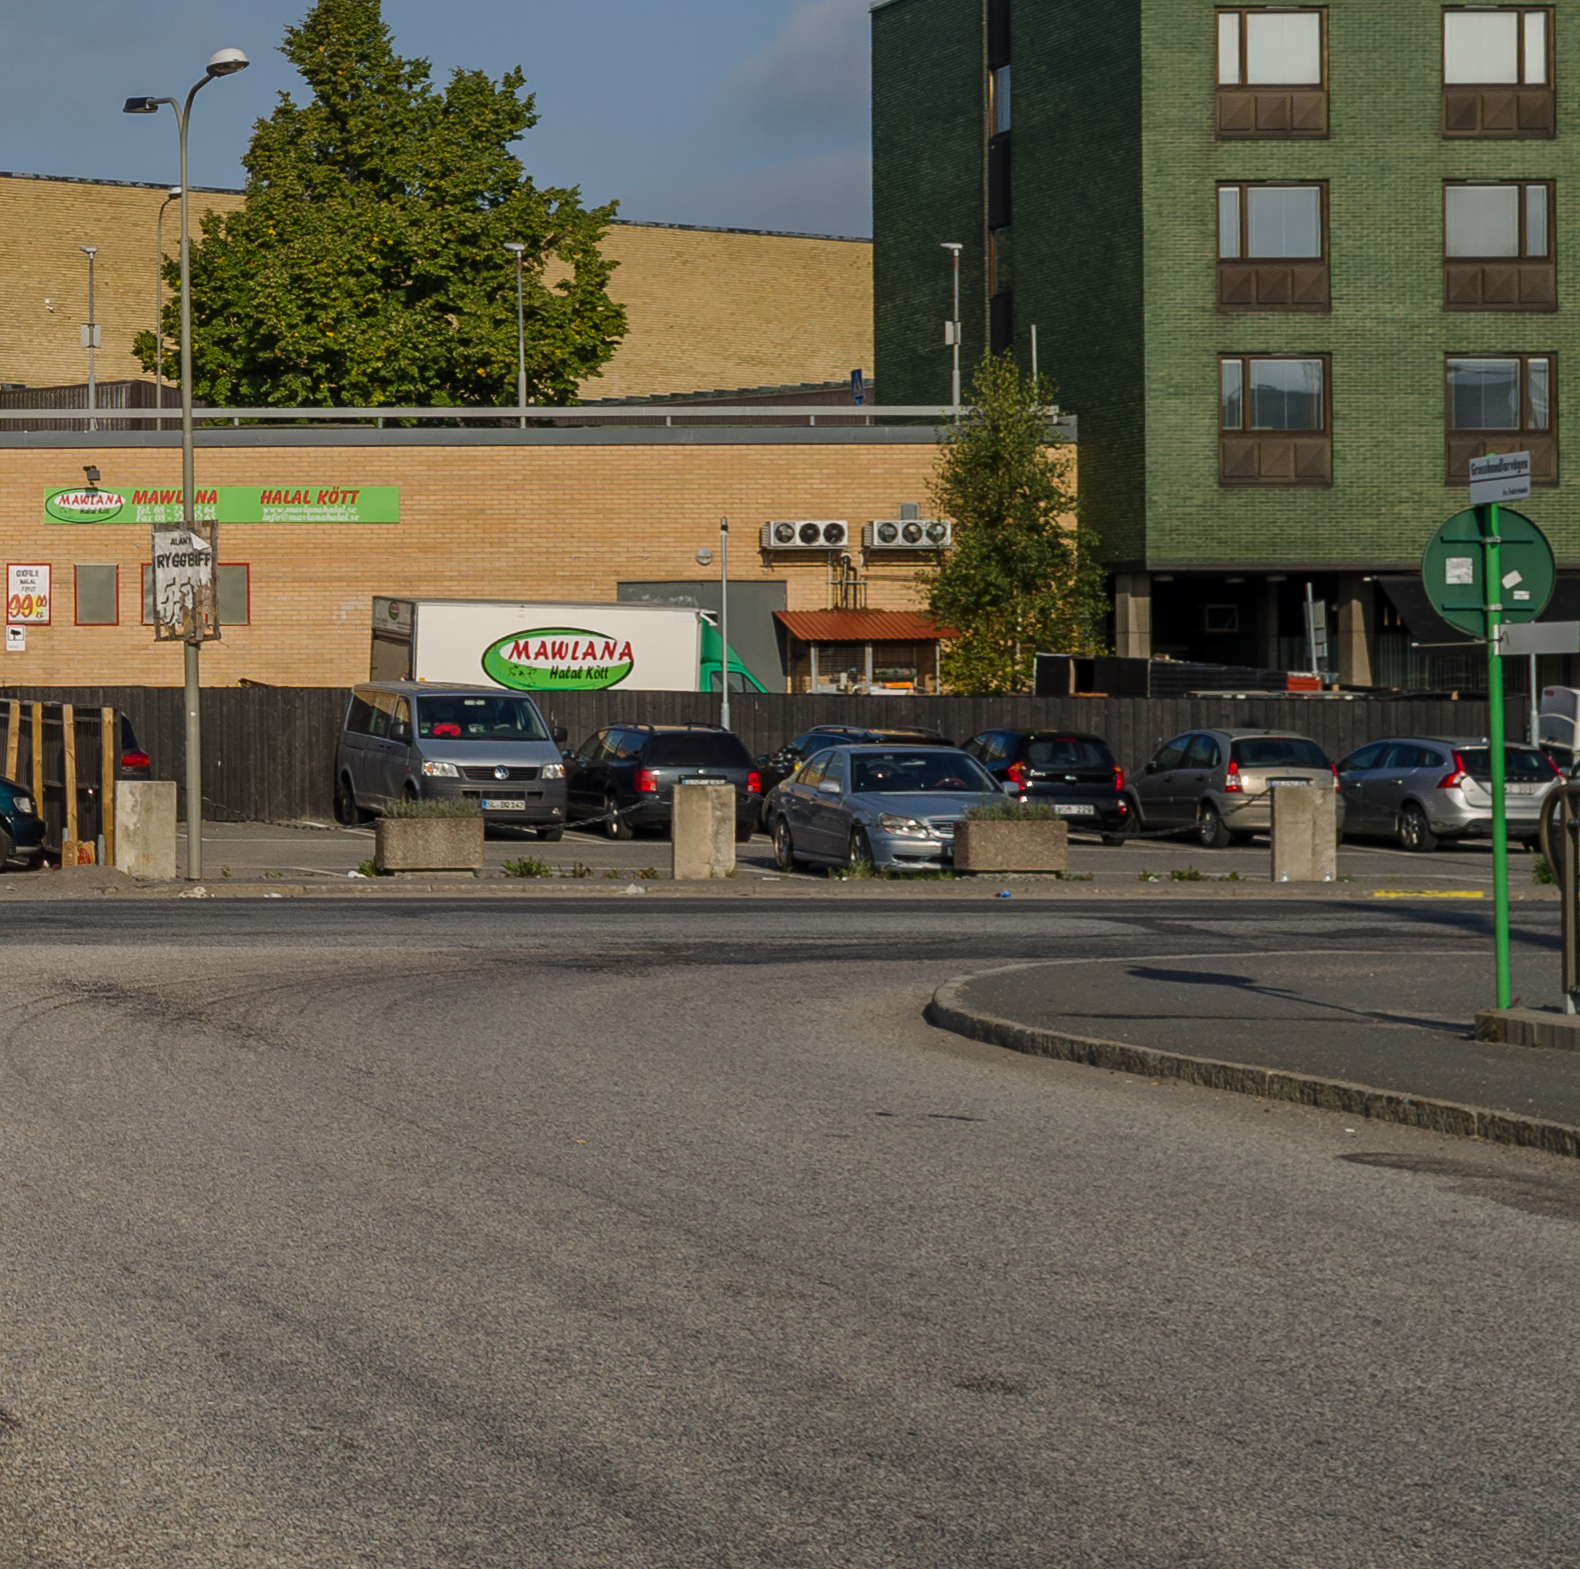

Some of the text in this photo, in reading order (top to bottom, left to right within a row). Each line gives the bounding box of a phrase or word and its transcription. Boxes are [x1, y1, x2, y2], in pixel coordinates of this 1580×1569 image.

[131, 486, 360, 505] MAWLNA HALAL KÖTT
[157, 552, 211, 569] RYGGBIFF
[508, 639, 634, 661] MAWLANA
[549, 664, 609, 679] Halal Kött
